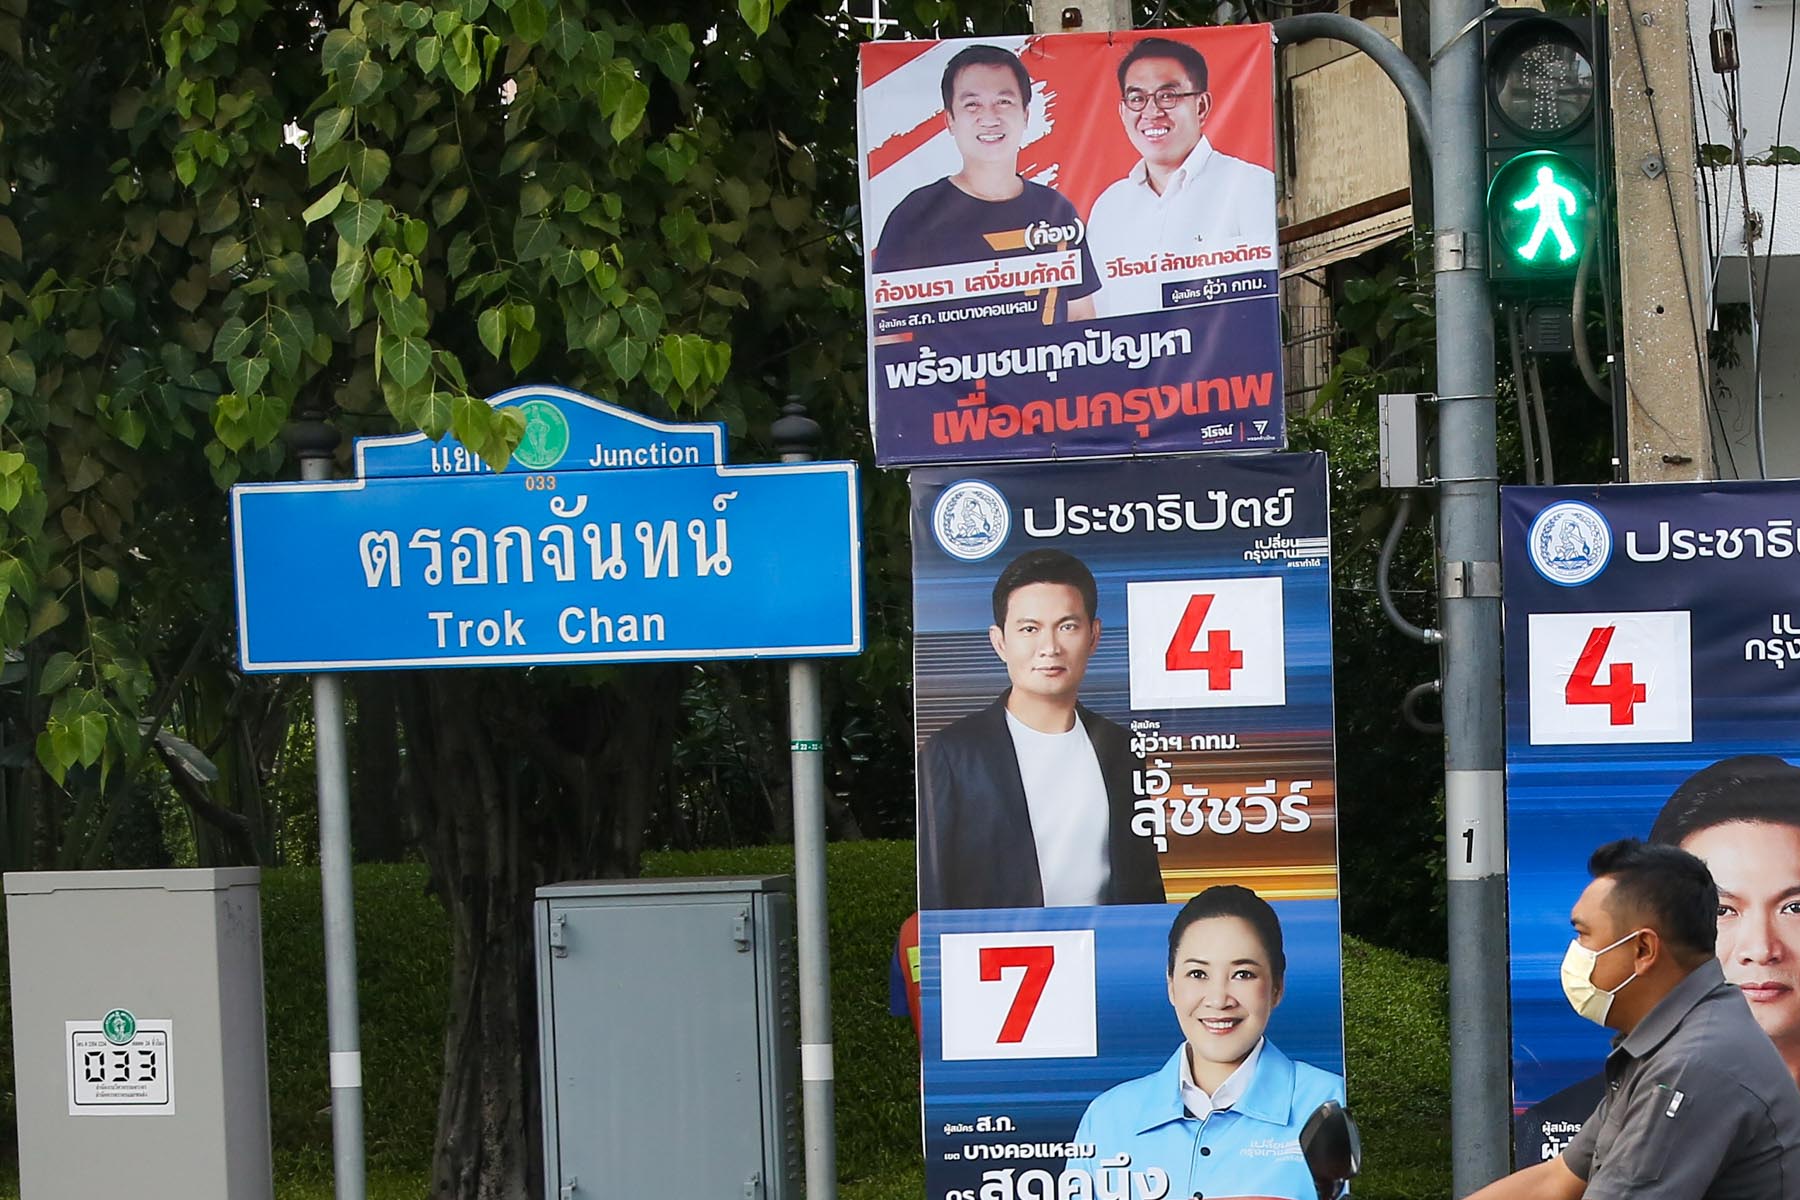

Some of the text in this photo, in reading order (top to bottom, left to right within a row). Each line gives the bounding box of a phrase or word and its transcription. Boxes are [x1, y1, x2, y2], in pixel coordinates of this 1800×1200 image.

[1024, 217, 1085, 250] (ก้อง)
[874, 253, 1076, 303] ก้องนรา เสงี่ยมศักดิ์
[1105, 244, 1272, 279] วิโรจน์ ลักขณาอดิศร
[1171, 276, 1267, 303] ผู้สมัคร ผู้ว่า กทม.
[878, 299, 1038, 331] ผู้สมัคร ส.ก. เขตบางคอแหลม
[885, 328, 1192, 389] พร้อมชนทุกปัญหา
[932, 371, 1274, 445] เพื่อคนกรุงเทพ
[1201, 424, 1234, 439] วิโรจน์
[589, 442, 699, 466] Junction
[525, 475, 556, 490] 033
[1024, 487, 1296, 538] ประชาธิปัตย์
[359, 490, 738, 588] ตรอกจันทน์
[1255, 533, 1299, 549] เปลี่ยน
[1244, 549, 1299, 564] กรุงเทพ
[428, 606, 665, 648] Trok Chan
[1165, 593, 1243, 691] 4
[1565, 626, 1646, 725] 4
[1130, 720, 1161, 731] ผู้สมัคร
[1130, 731, 1241, 759] ผู้ว่าฯ กทม.
[1132, 758, 1172, 795] เอ้
[1130, 779, 1312, 852] สุชัชวีร์
[1462, 828, 1474, 863] 1
[979, 945, 1055, 1044] 7
[85, 1050, 156, 1082] 033
[943, 1115, 1016, 1136] ผู้สมัคร ส.ก.
[1542, 1121, 1581, 1136] ผู้สมัคร
[963, 1141, 1096, 1160] บางคอแหลม
